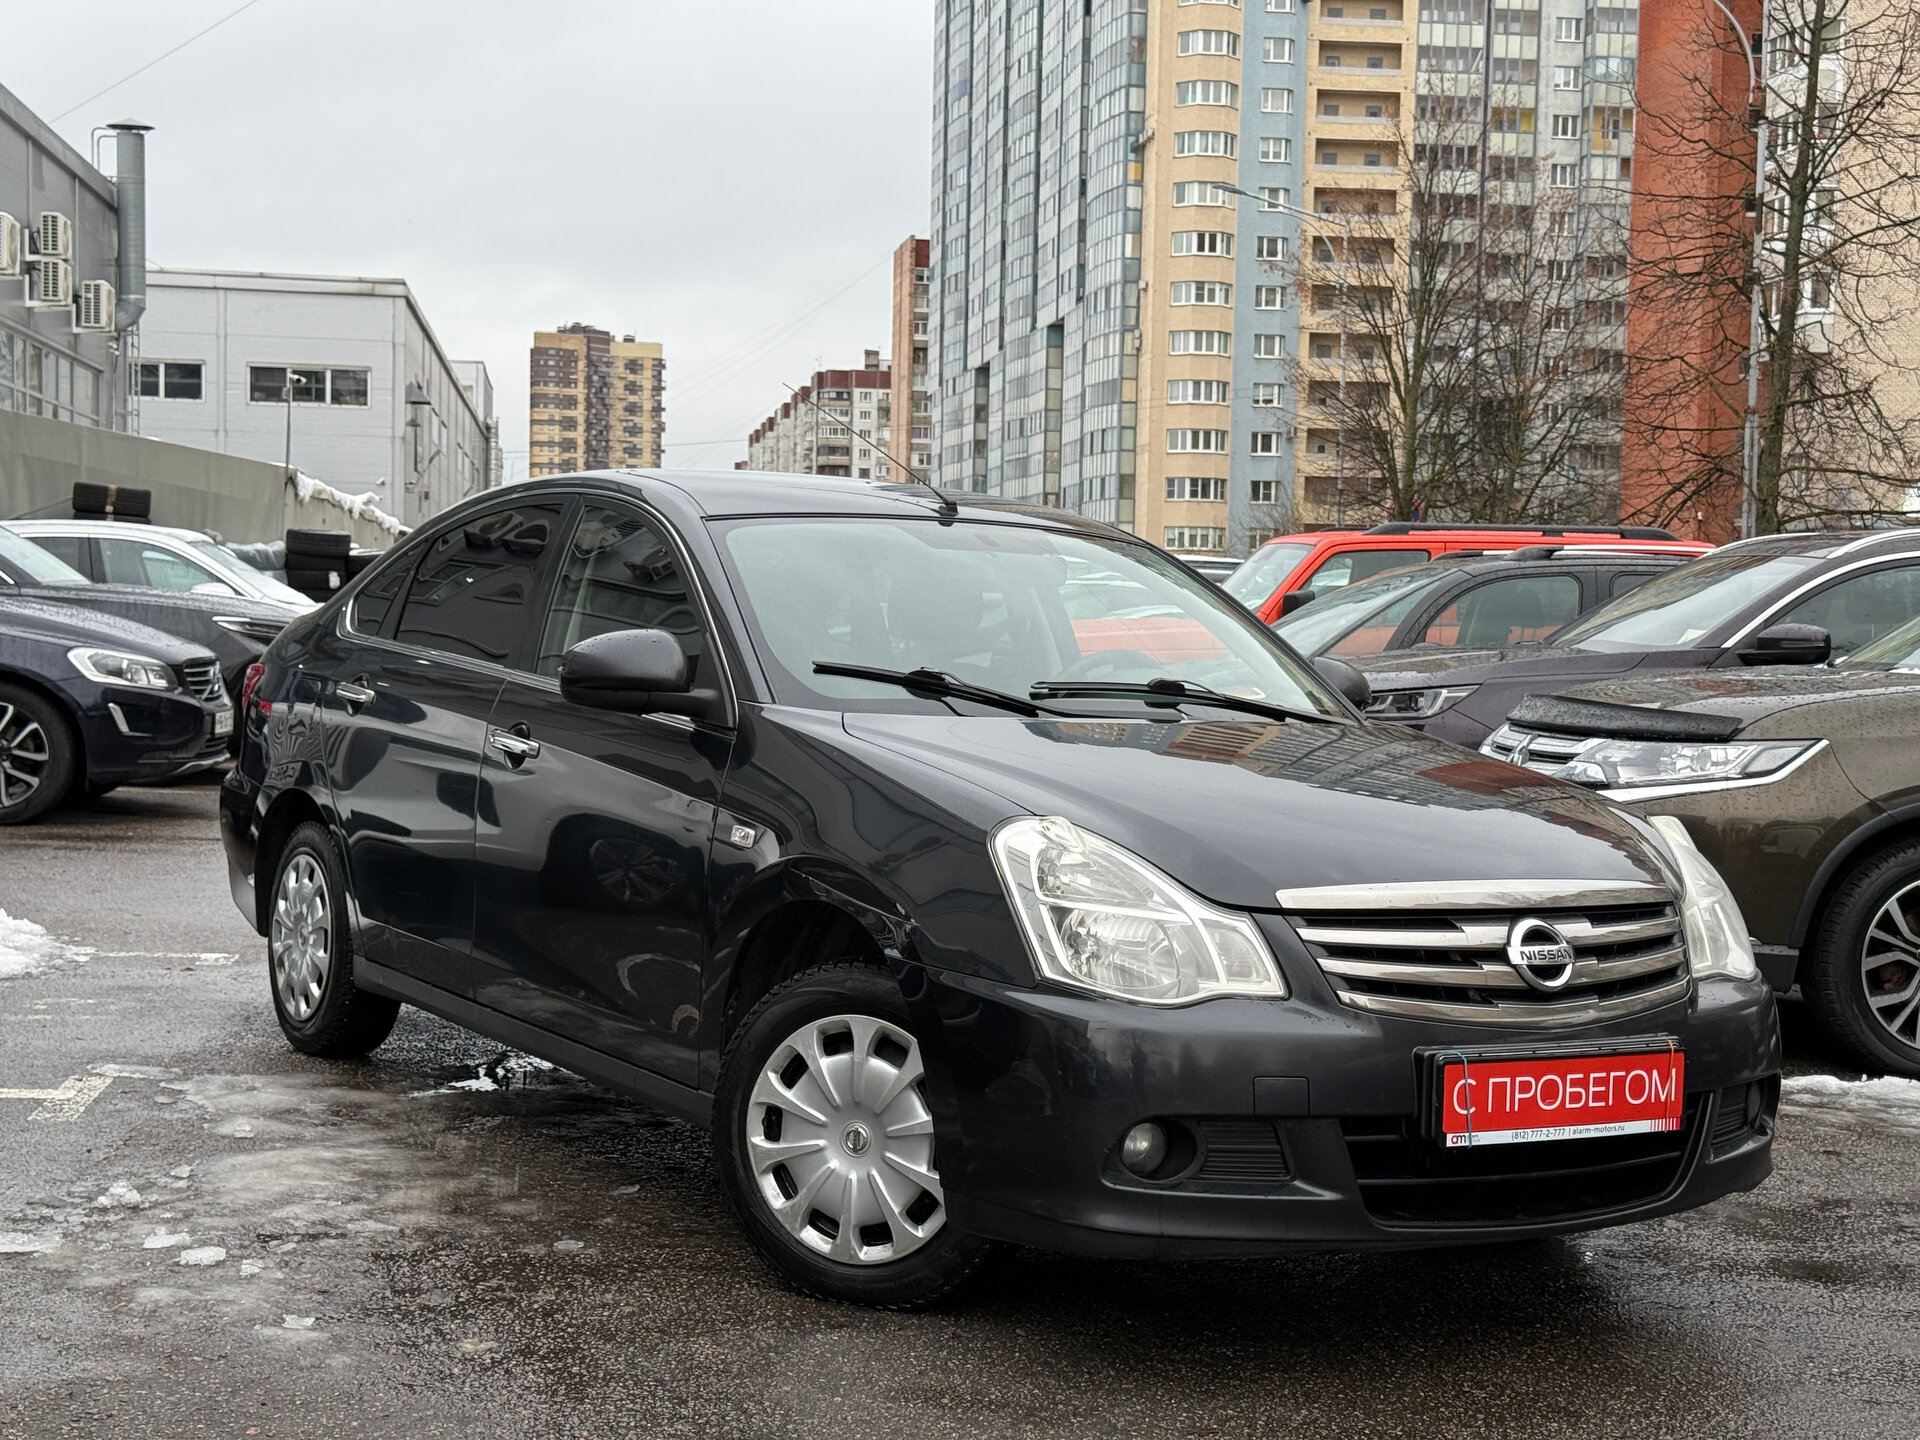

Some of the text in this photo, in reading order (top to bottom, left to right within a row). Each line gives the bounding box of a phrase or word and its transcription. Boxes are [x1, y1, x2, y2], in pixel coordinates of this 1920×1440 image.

[1520, 949, 1573, 961] NISSAN
[1452, 1067, 1677, 1115] С ПРОБЕГОМ
[1511, 1124, 1626, 1141] (812) 777-2-777 alarm-motors.ru
